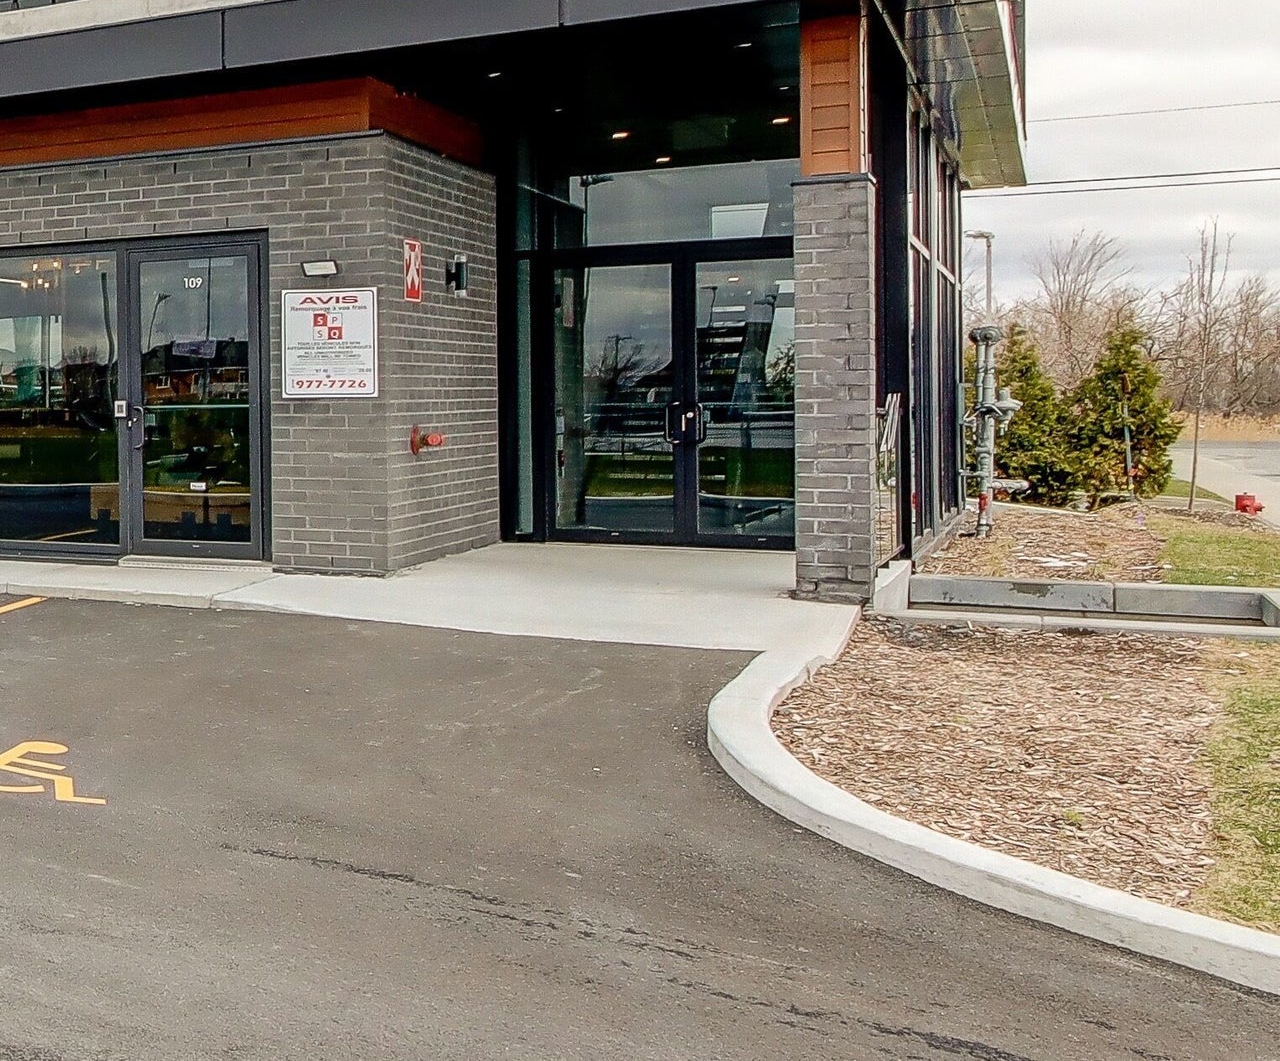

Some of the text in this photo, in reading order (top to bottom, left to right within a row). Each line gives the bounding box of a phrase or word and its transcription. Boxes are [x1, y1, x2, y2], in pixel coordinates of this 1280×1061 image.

[184, 277, 203, 289] 109
[299, 295, 359, 305] AVIS
[317, 316, 338, 325] S P
[317, 330, 339, 339] S Q
[295, 379, 367, 389] 977-7726
